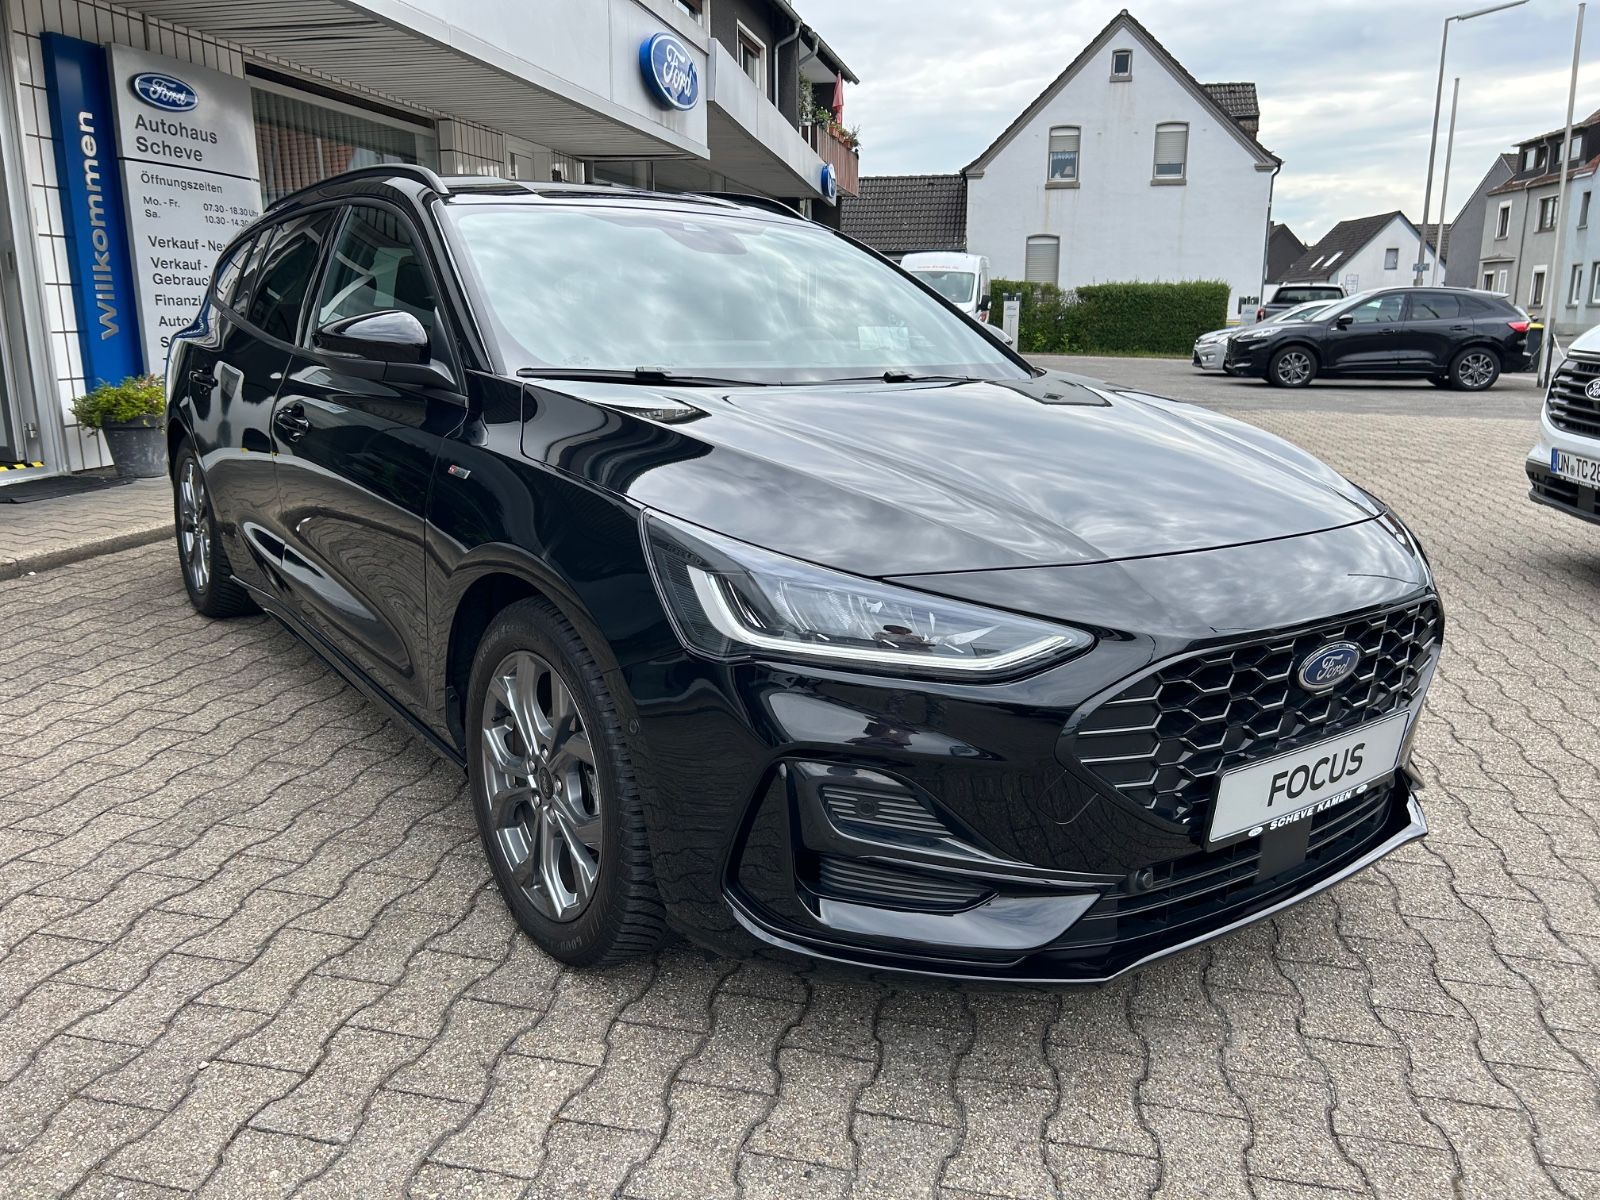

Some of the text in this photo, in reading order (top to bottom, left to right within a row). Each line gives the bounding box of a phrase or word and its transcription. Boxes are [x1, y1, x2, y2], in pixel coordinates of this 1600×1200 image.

[663, 44, 692, 97] Ford
[149, 79, 187, 106] Ford
[135, 114, 218, 144] Autohaus
[136, 136, 203, 161] Scheve
[141, 170, 223, 194] Öffnungszeiten
[143, 196, 162, 206] Mo.
[169, 199, 180, 208] Fr.
[145, 209, 160, 218] Sa.
[203, 203, 224, 213] 07.30
[78, 110, 120, 341] Willkommen
[205, 215, 225, 225] 10.30
[148, 235, 199, 250] Verkauf
[151, 257, 201, 271] Verkauf
[159, 315, 192, 327] Auto
[1558, 453, 1570, 474] UN
[1576, 458, 1588, 479] TC
[1316, 653, 1351, 681] Ford
[1266, 742, 1366, 808] FOCUS
[1269, 790, 1352, 831] SCHEVE KAMEN
